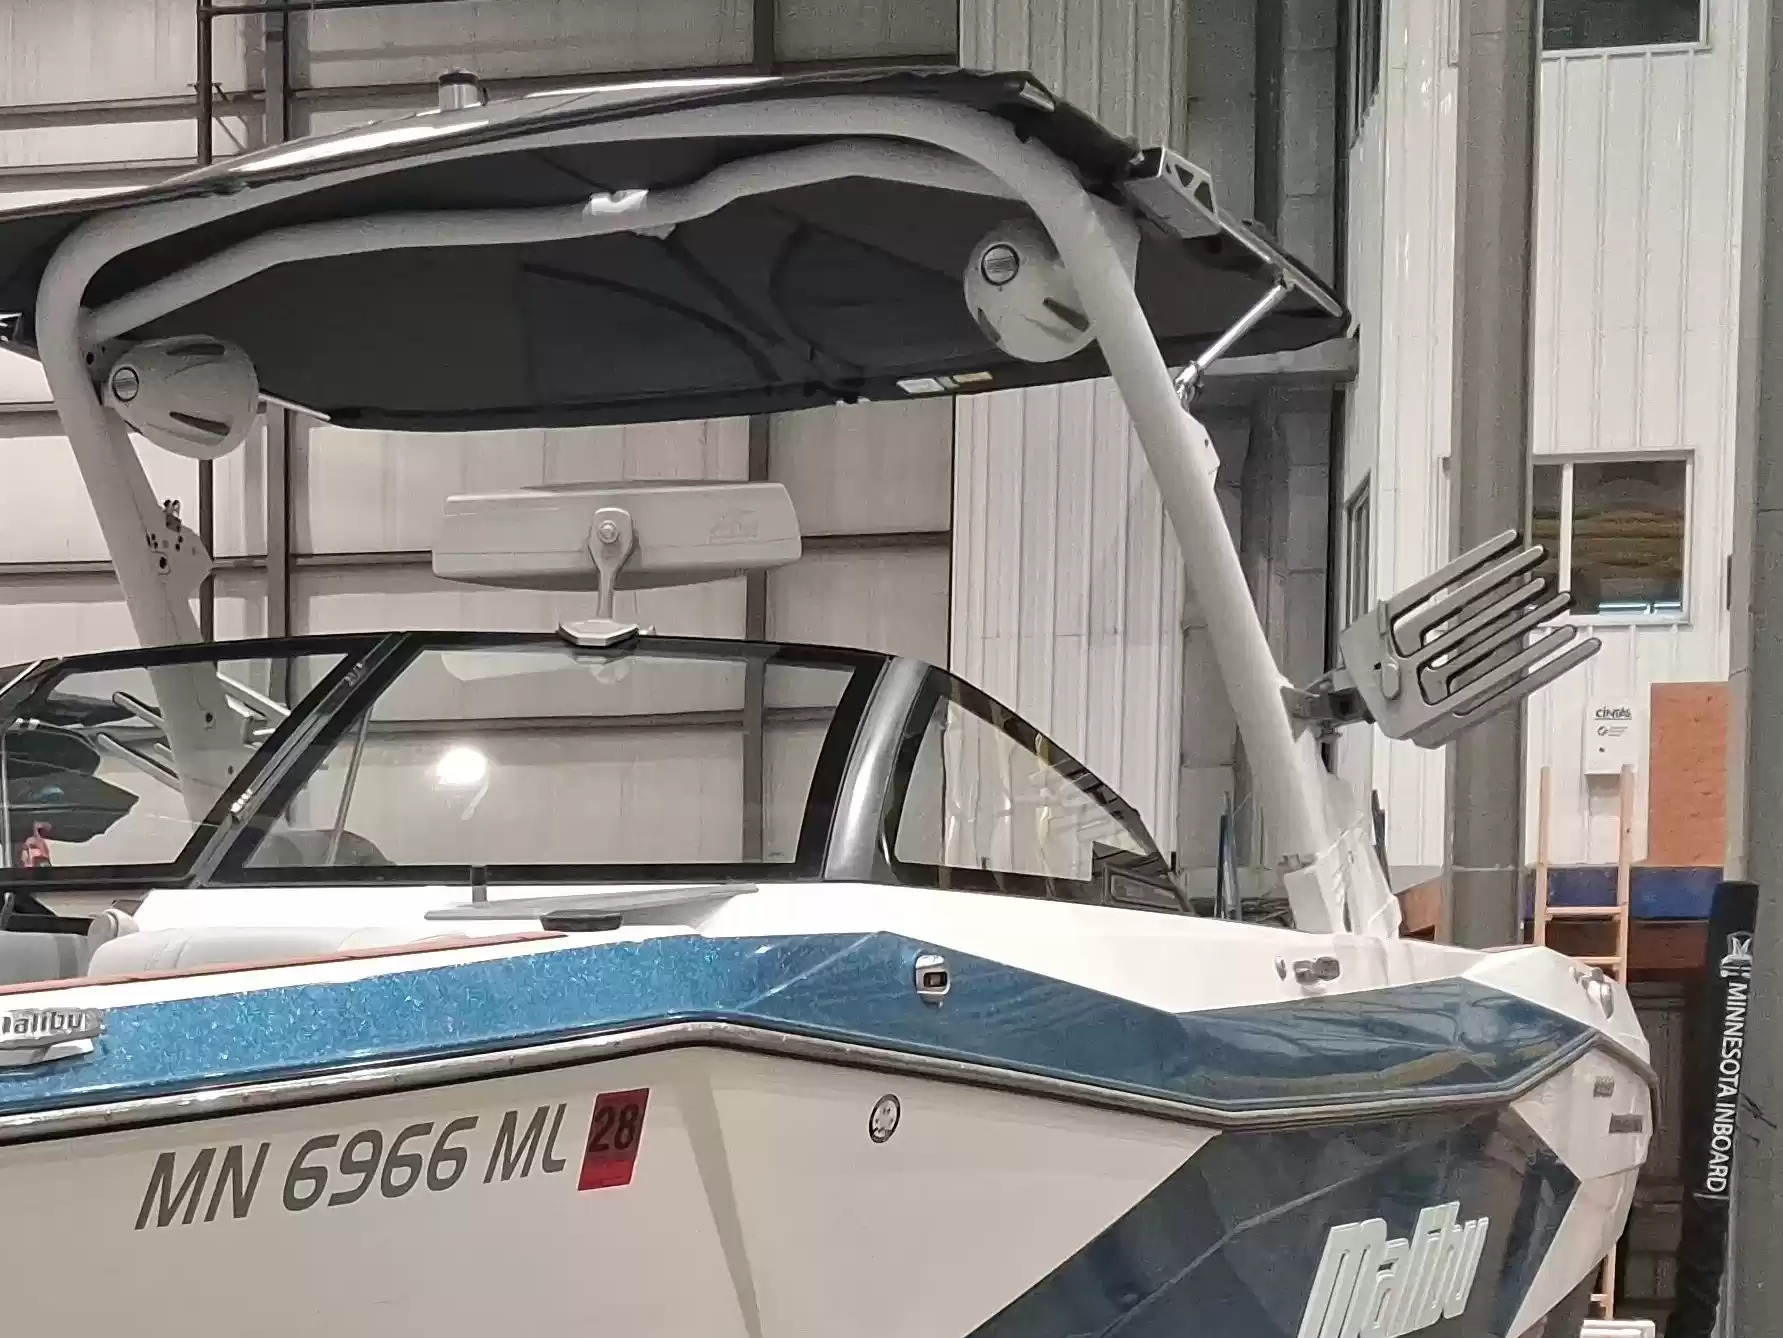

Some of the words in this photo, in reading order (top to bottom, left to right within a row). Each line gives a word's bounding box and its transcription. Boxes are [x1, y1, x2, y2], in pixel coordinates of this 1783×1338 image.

[1716, 982, 1748, 1098] MINNESOTA
[134, 1142, 270, 1231] MN
[282, 1118, 478, 1212] 6966
[484, 1103, 568, 1184] ML
[589, 1103, 639, 1152] 28
[1706, 1102, 1737, 1193] INBOARD
